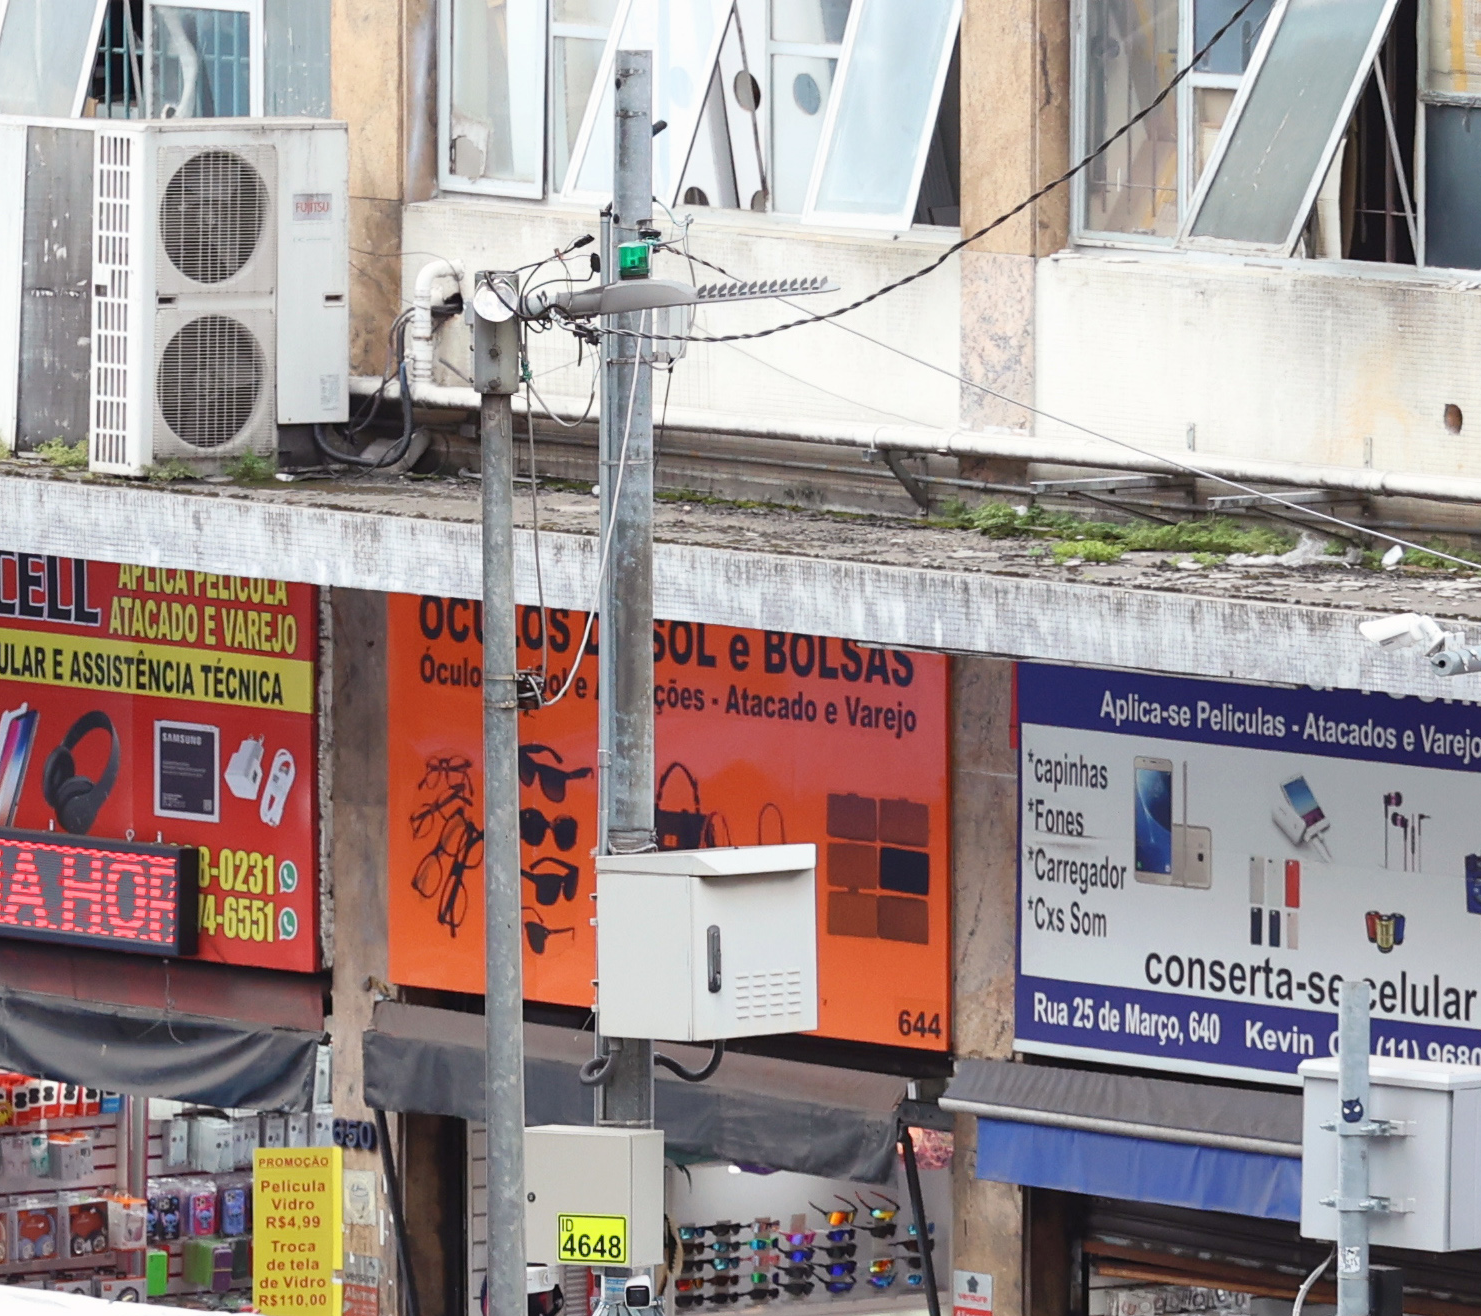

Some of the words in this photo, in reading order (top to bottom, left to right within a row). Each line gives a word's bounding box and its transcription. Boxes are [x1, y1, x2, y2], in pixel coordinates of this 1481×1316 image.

[108, 595, 198, 643] ATACADO
[204, 605, 217, 646] E
[221, 607, 298, 655] VAREJO
[419, 595, 570, 653] OCOS
[729, 633, 749, 672] e
[764, 630, 914, 687] BOLSAS
[52, 648, 63, 681] E
[69, 649, 195, 696] ASSISTÊNCIA
[200, 657, 283, 705] TÉCNICA
[420, 646, 483, 687] Óculo
[725, 684, 817, 722] Atacado
[825, 701, 838, 725] e
[845, 695, 917, 739] Varejo
[1100, 690, 1191, 728] Aplica-se
[1197, 701, 1286, 739] Peliculas
[1304, 712, 1397, 750] Atacados
[1403, 730, 1415, 750] e
[1071, 901, 1108, 938] Som
[1145, 951, 1344, 1005] conserta-se
[898, 1007, 942, 1040] 644
[1034, 992, 1069, 1026] Rua
[1073, 997, 1094, 1029] 25
[1098, 1000, 1120, 1032] de
[1125, 1004, 1184, 1046] Março,
[1189, 1010, 1221, 1045] 640
[1245, 1020, 1314, 1055] Kevin
[333, 1118, 376, 1150] 650
[258, 1156, 329, 1169] PROMOÇÃO
[271, 1198, 315, 1211] Vidro
[266, 1216, 321, 1230] R$4,99
[561, 1218, 574, 1233] ID
[271, 1240, 316, 1253] Troca
[562, 1233, 622, 1259] 4648
[266, 1259, 286, 1271] de
[290, 1258, 320, 1271] tela
[259, 1277, 279, 1289] de
[283, 1276, 326, 1289] Vidro
[258, 1294, 327, 1308] R$110,00
